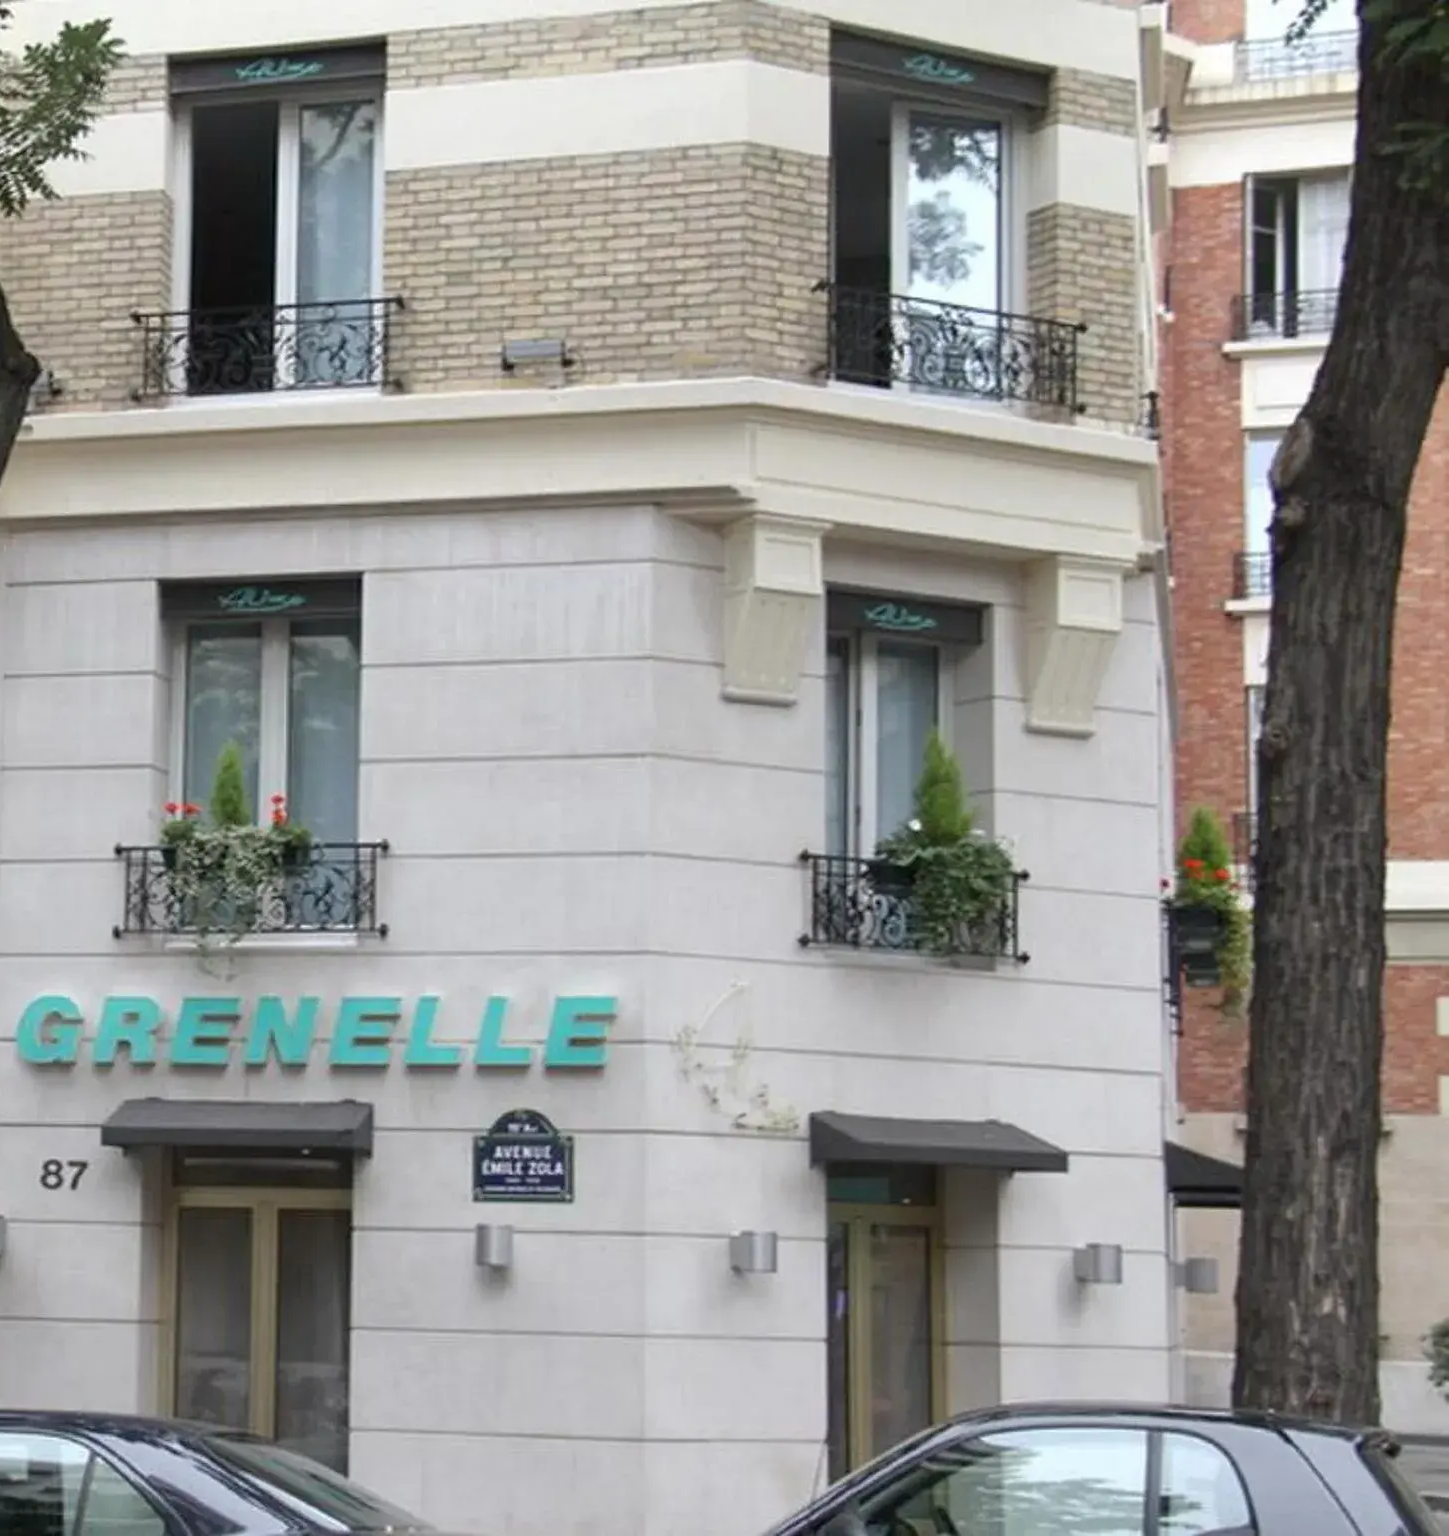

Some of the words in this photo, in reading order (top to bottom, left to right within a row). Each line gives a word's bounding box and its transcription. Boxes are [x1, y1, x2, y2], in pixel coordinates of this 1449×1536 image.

[15, 995, 617, 1068] GRENELLE
[494, 1144, 552, 1159] AVENUE
[40, 1159, 88, 1190] 87
[481, 1159, 523, 1175] ÉMILE
[527, 1161, 563, 1175] ZOLA
